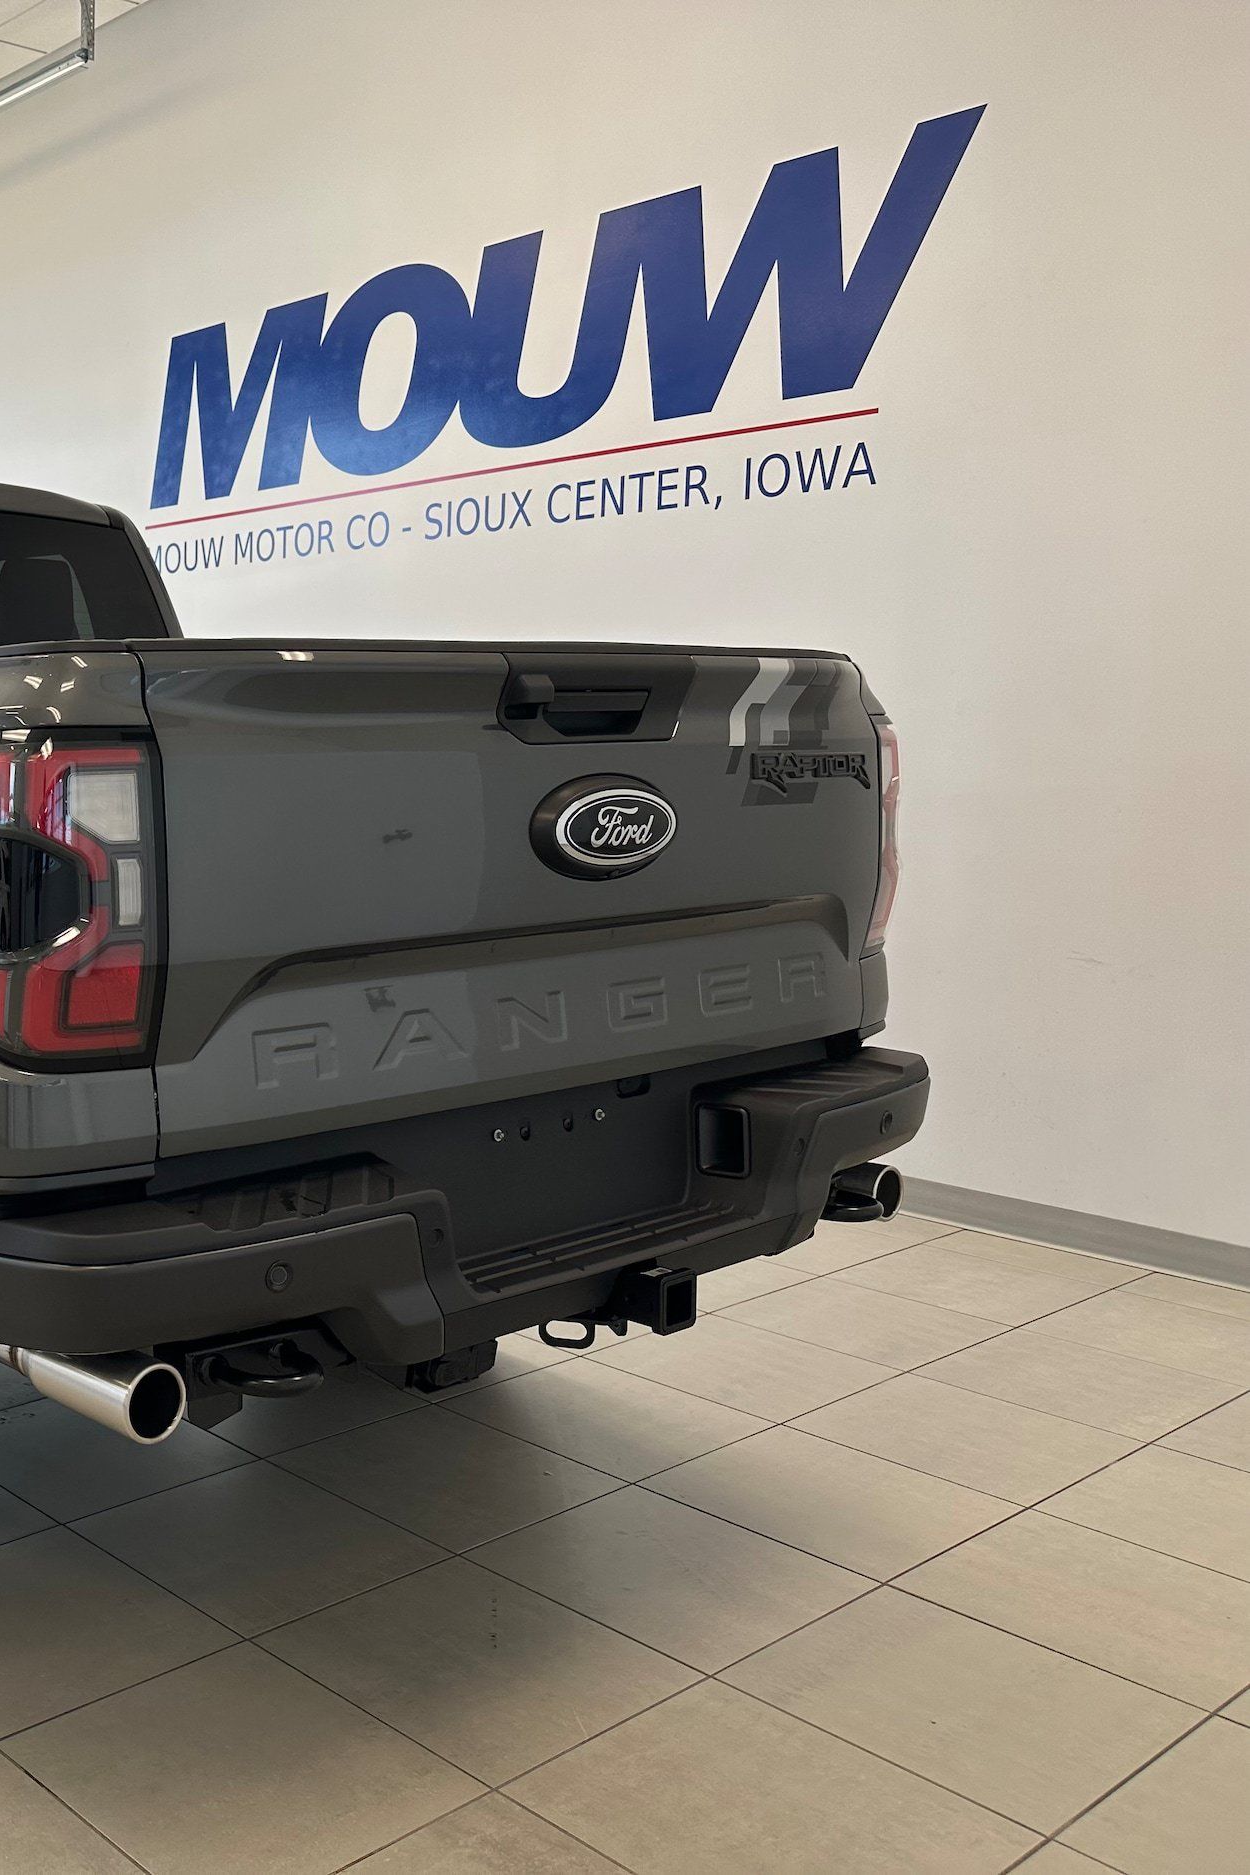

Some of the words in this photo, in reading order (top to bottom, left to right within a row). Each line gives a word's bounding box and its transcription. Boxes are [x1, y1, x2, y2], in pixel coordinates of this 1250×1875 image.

[149, 105, 987, 508] MOUW
[234, 519, 334, 566] MOTOR
[346, 511, 390, 550] CO
[424, 488, 533, 541] SIOUX
[546, 464, 723, 525] CENTER,
[744, 441, 877, 501] IOWA
[590, 806, 655, 847] Ford
[750, 751, 871, 797] RAPTOR
[251, 952, 825, 1090] RANGER
